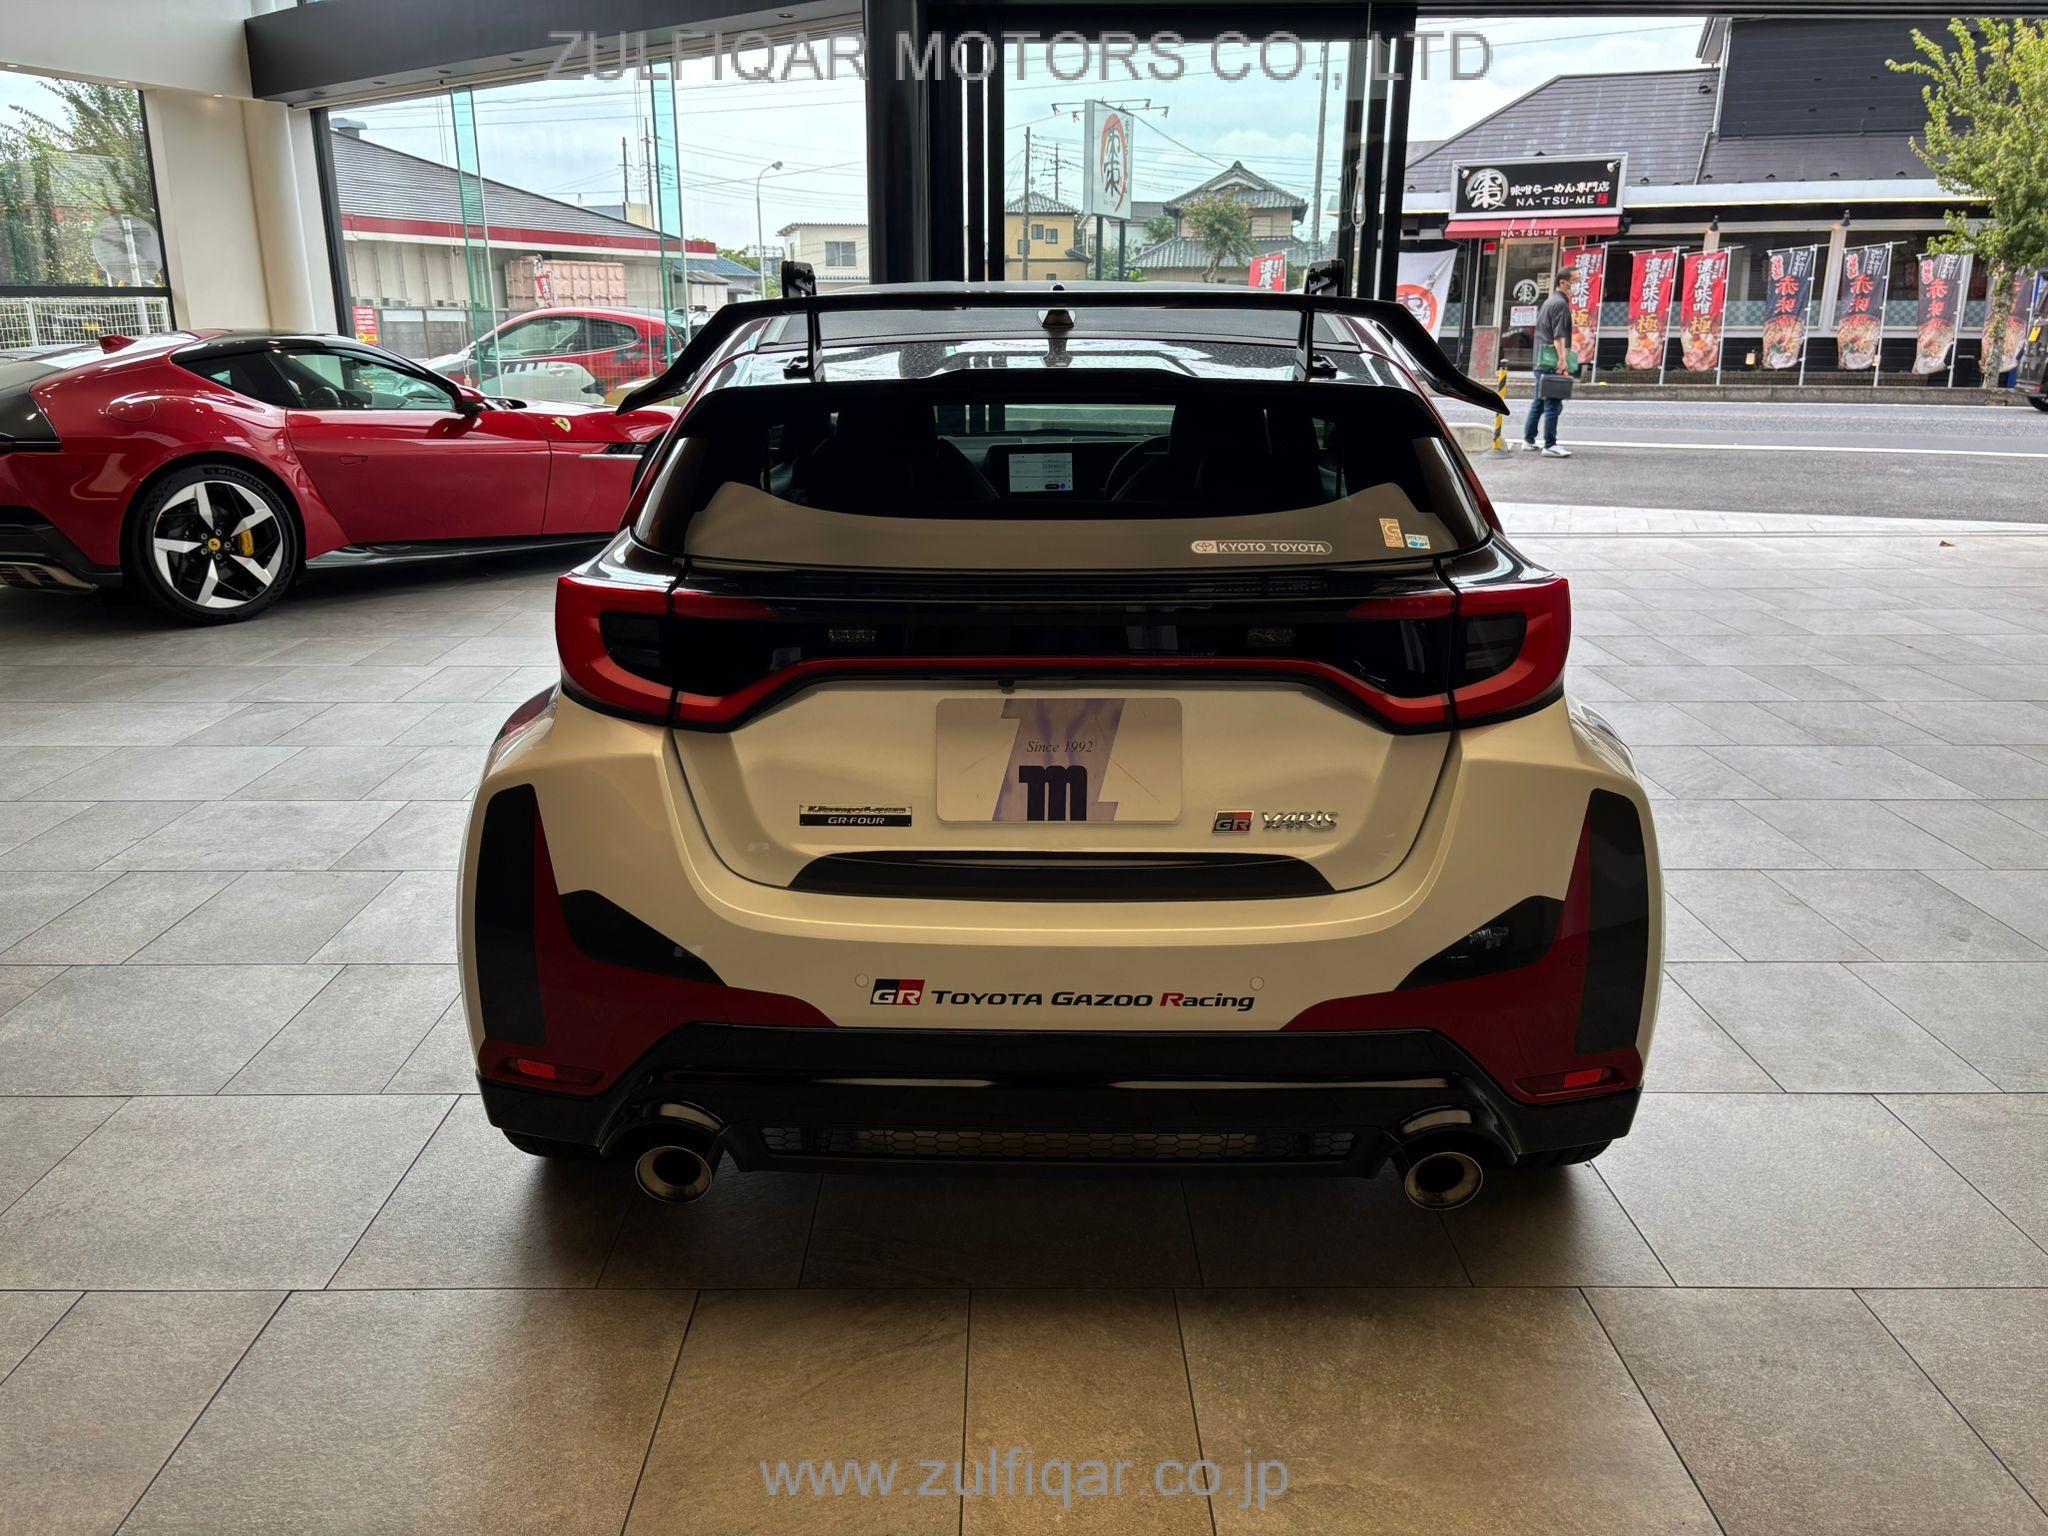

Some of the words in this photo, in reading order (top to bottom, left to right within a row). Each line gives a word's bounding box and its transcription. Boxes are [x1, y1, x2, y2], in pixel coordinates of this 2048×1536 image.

[1509, 181, 1611, 197] 味噌らーめん専門店
[1515, 194, 1595, 207] NA-TSU-ME
[1219, 542, 1266, 553] KYOTO
[1271, 542, 1326, 554] TOYOTA
[1026, 741, 1060, 753] Since
[1064, 741, 1095, 754] 1992
[872, 988, 921, 1006] GR
[931, 990, 1043, 1007] TOYOTA
[1051, 991, 1154, 1007] GAZOO
[1160, 991, 1255, 1012] Racing
